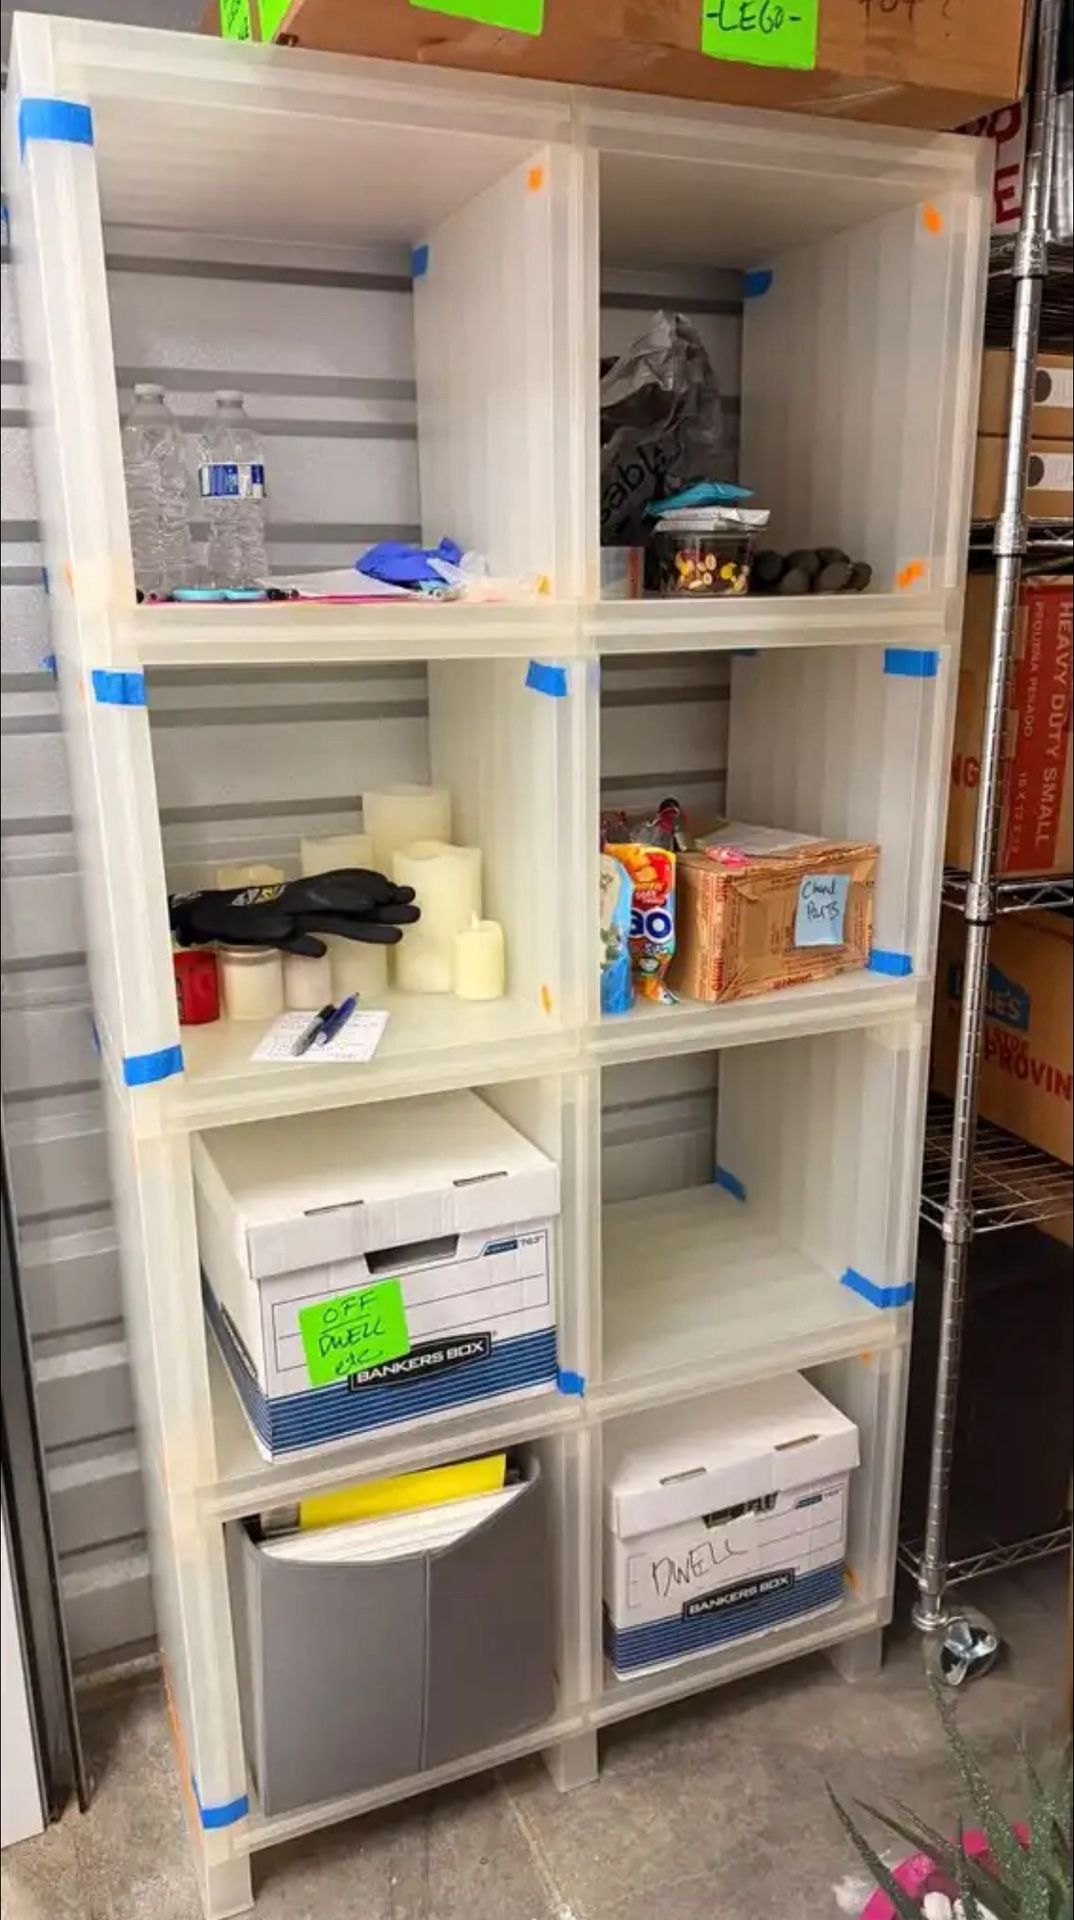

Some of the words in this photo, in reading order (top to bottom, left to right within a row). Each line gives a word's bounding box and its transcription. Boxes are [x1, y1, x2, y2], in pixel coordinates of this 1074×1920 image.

[1053, 602, 1073, 686] HEAVY
[1045, 693, 1067, 758] DUTY
[1034, 767, 1058, 852] SMALL
[322, 1289, 378, 1324] OFF
[318, 1315, 387, 1357] DWELL
[356, 1350, 445, 1384] BANKERS
[446, 1340, 485, 1360] BOX
[689, 1585, 758, 1615] BANKERS
[759, 1574, 789, 1593] BOX
